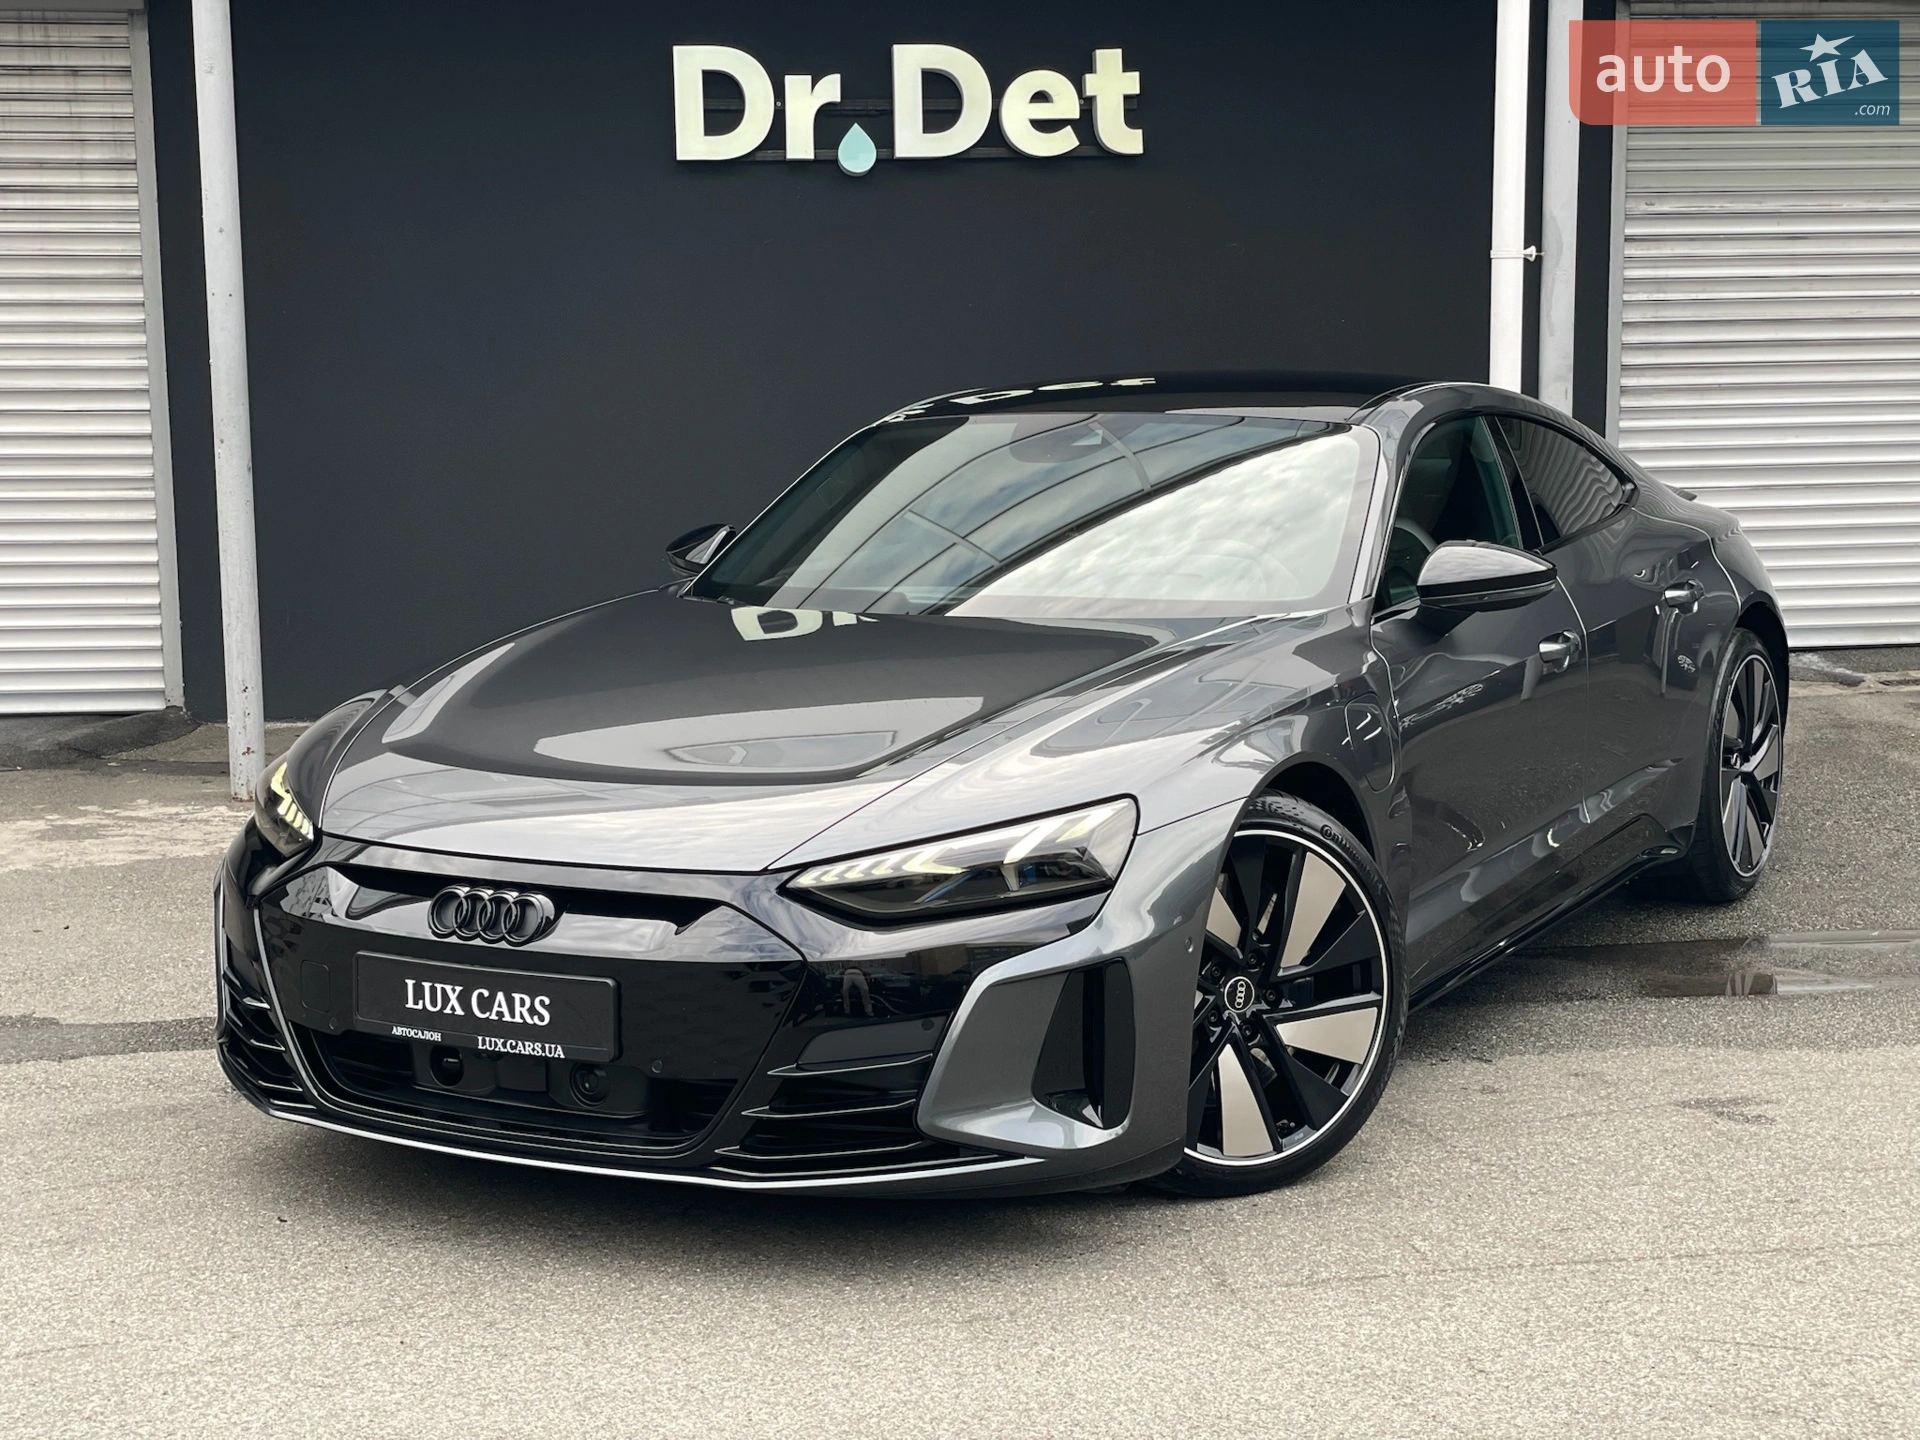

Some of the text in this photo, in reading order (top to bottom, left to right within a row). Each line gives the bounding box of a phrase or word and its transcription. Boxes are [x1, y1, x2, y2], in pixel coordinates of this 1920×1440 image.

[404, 978, 551, 1026] LUX CARS
[391, 1025, 442, 1042] АВТОСАЛОН
